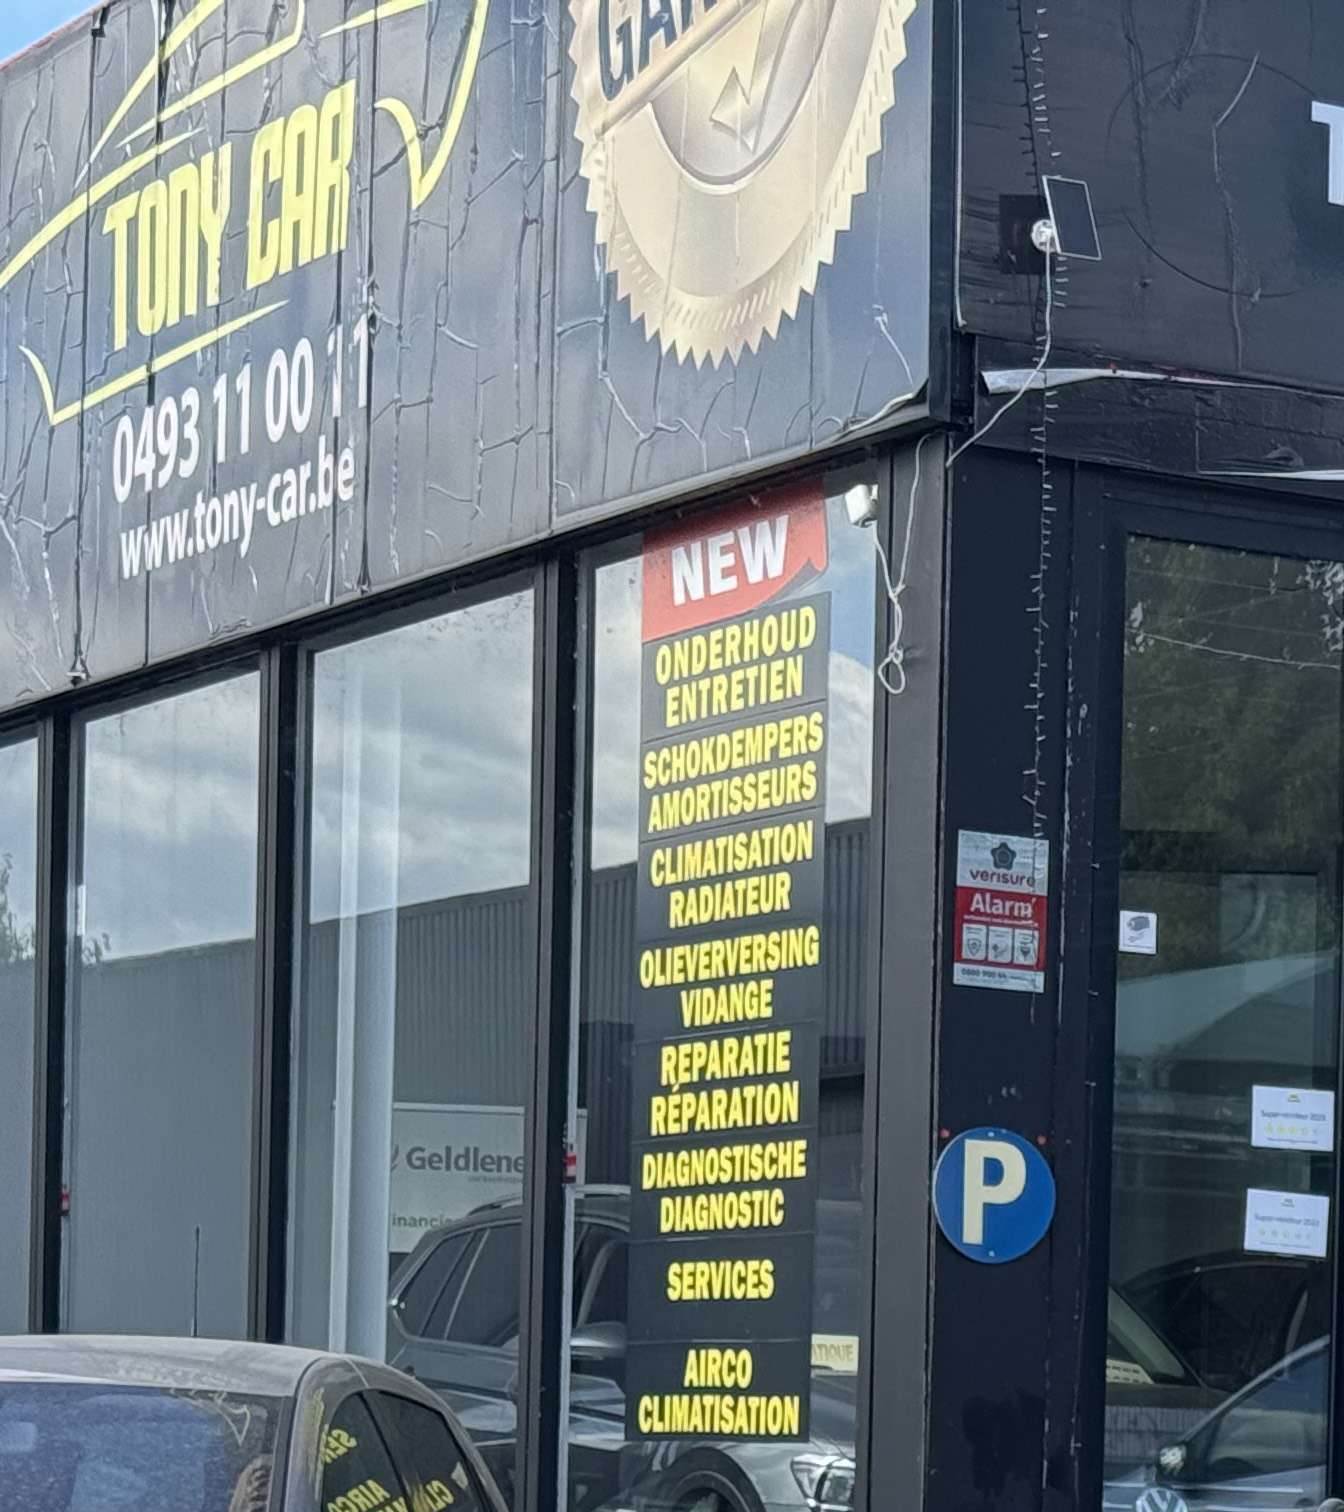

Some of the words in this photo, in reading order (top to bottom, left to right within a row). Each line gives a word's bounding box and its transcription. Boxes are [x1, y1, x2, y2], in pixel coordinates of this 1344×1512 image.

[103, 141, 234, 351] TONY
[247, 78, 356, 290] CAR
[113, 387, 200, 503] 0493
[213, 363, 251, 463] 11
[265, 337, 313, 443] 00
[121, 435, 354, 579] www.tony-car.be
[670, 515, 789, 606] NEW
[655, 606, 816, 685] ONDERHOUD
[665, 655, 803, 728] ENTRETIEN
[644, 712, 824, 789] SCHOKDEMPERS
[648, 761, 817, 833] AMORTISSEURS
[651, 820, 814, 887] CLIMATISATION
[970, 869, 1035, 888] verisure
[669, 872, 791, 928] RADIATEUR
[970, 892, 1032, 918] Alarm
[640, 926, 820, 989] OLIEVERVERSING
[680, 979, 774, 1028] VIDANGE
[661, 1030, 791, 1086] REPARATIE
[651, 1081, 799, 1136] RÉPARATION
[642, 1139, 807, 1190] DIAGNOSTISCHE
[963, 1139, 1027, 1245] P
[660, 1189, 784, 1233] DIAGNOSTIC
[667, 1259, 775, 1301] SERVICES
[684, 1349, 753, 1388] AIRCO
[638, 1395, 800, 1435] CLIMATISATION
